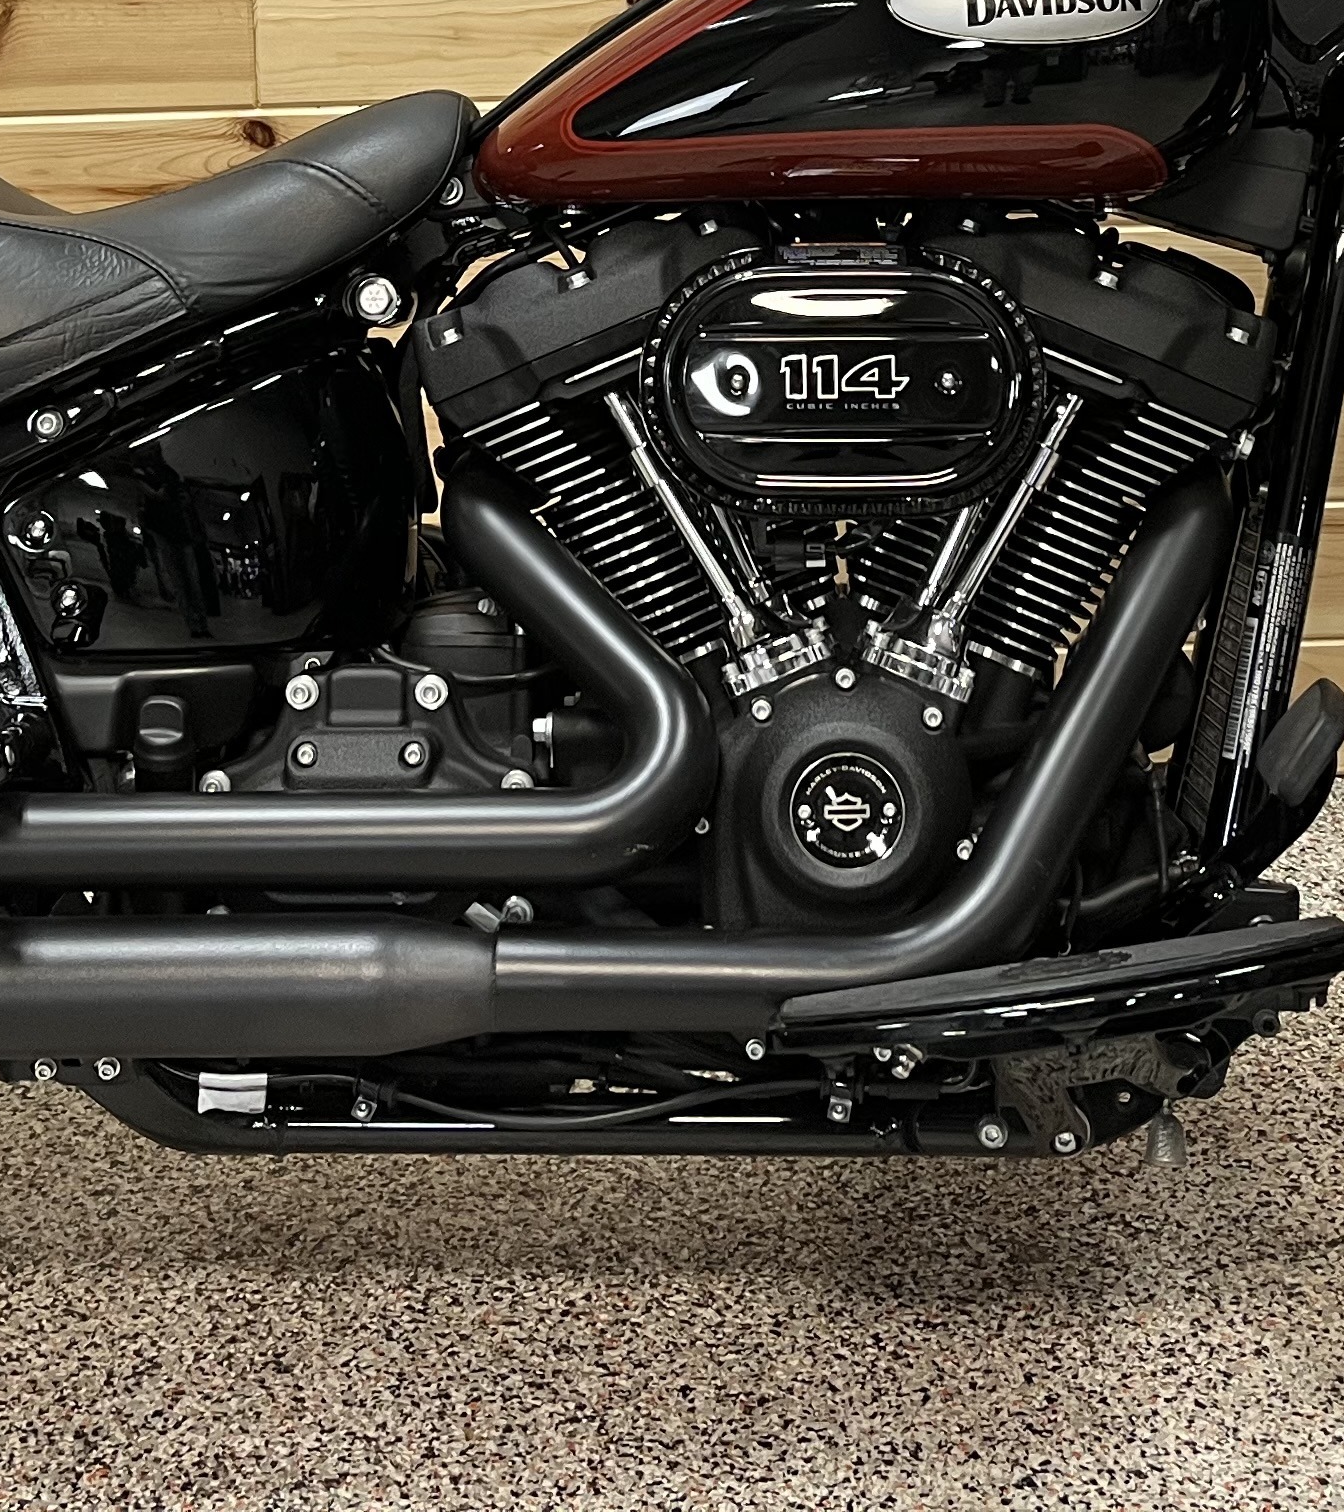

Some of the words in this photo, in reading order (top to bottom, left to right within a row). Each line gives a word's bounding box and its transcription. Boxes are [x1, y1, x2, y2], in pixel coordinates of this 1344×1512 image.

[779, 353, 911, 401] 114
[786, 402, 834, 410] CUBIC
[844, 402, 901, 410] INCHES
